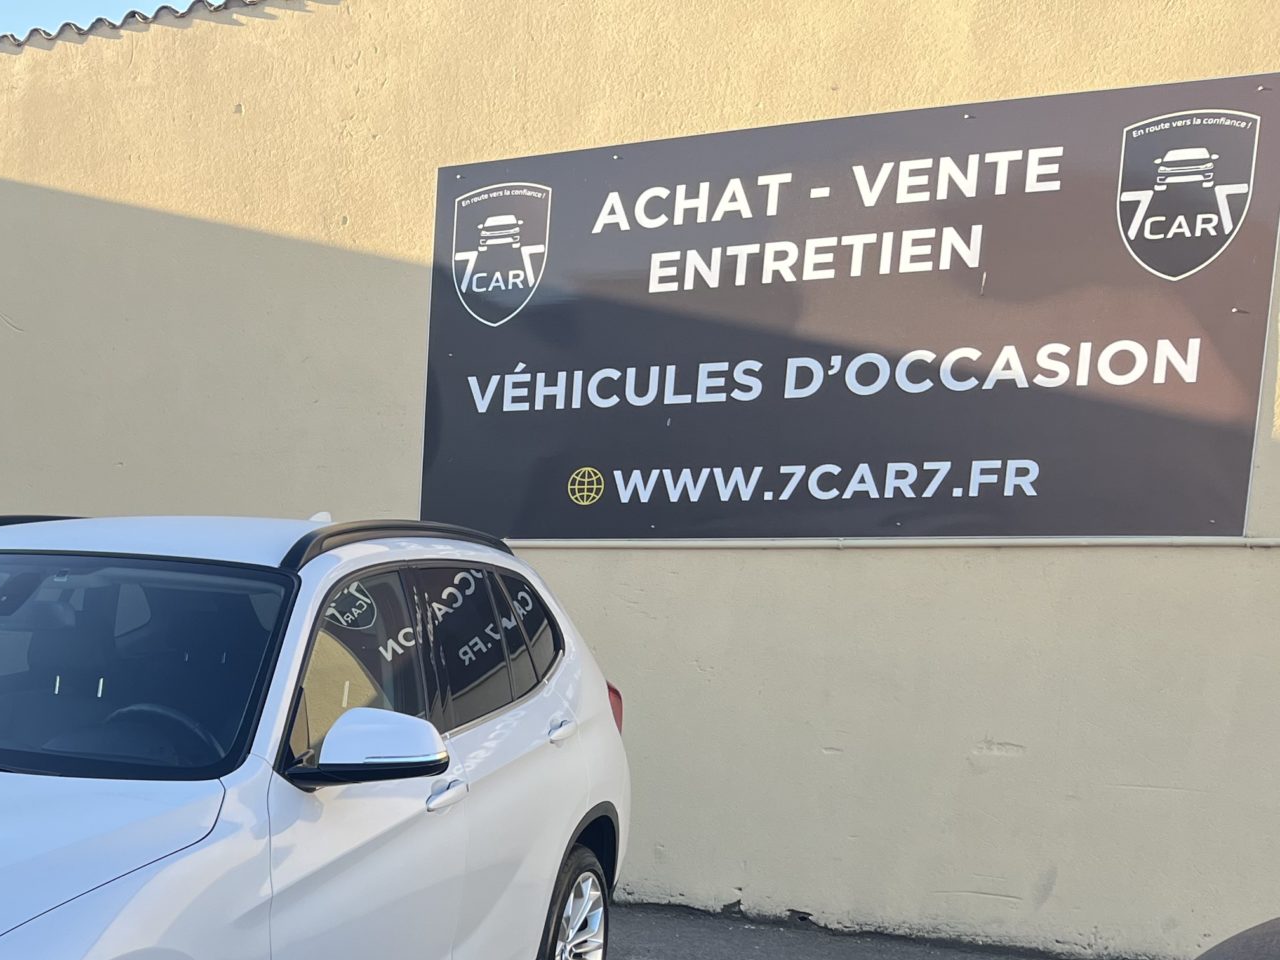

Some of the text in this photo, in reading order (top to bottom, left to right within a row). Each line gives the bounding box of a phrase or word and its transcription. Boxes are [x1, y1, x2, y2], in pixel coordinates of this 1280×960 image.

[1146, 122, 1170, 135] route
[1172, 118, 1191, 128] vers
[1193, 117, 1202, 125] la
[1203, 117, 1246, 129] confiance
[591, 171, 793, 235] ACHAT
[852, 146, 1064, 209] VENTE
[648, 225, 984, 295] ENTRETIEN
[468, 338, 1201, 414] VÉHICULES D'OCCASION
[614, 459, 1039, 505] WWW.7CAR7.FR
